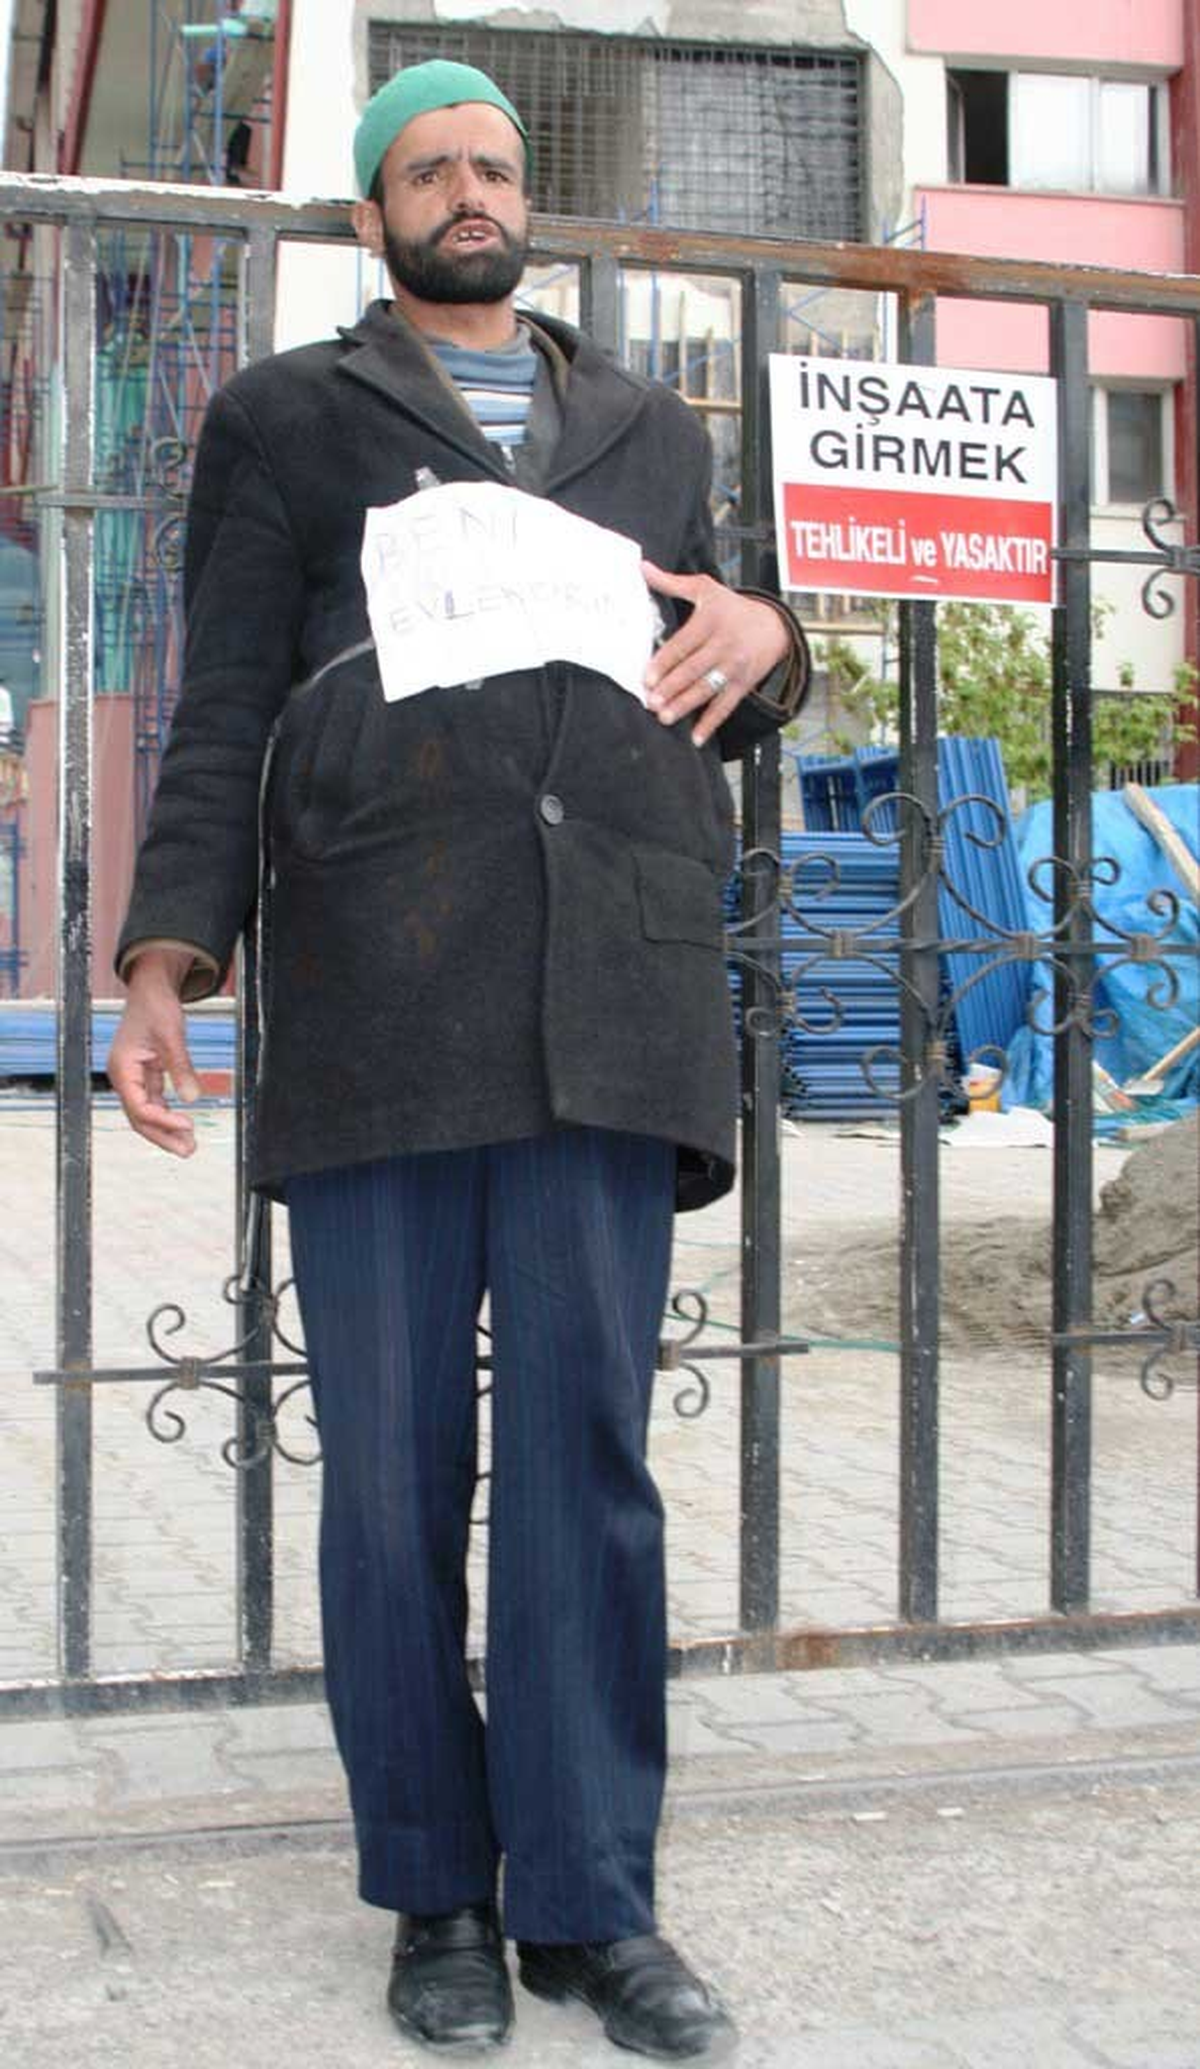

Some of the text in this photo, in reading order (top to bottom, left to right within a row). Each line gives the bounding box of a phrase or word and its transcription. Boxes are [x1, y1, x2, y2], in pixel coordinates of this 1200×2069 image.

[800, 361, 1035, 428] İNŞAATA
[809, 423, 1028, 484] GİRMEK
[790, 516, 1049, 575] TEHLİKELİ ve YASAKTIR
